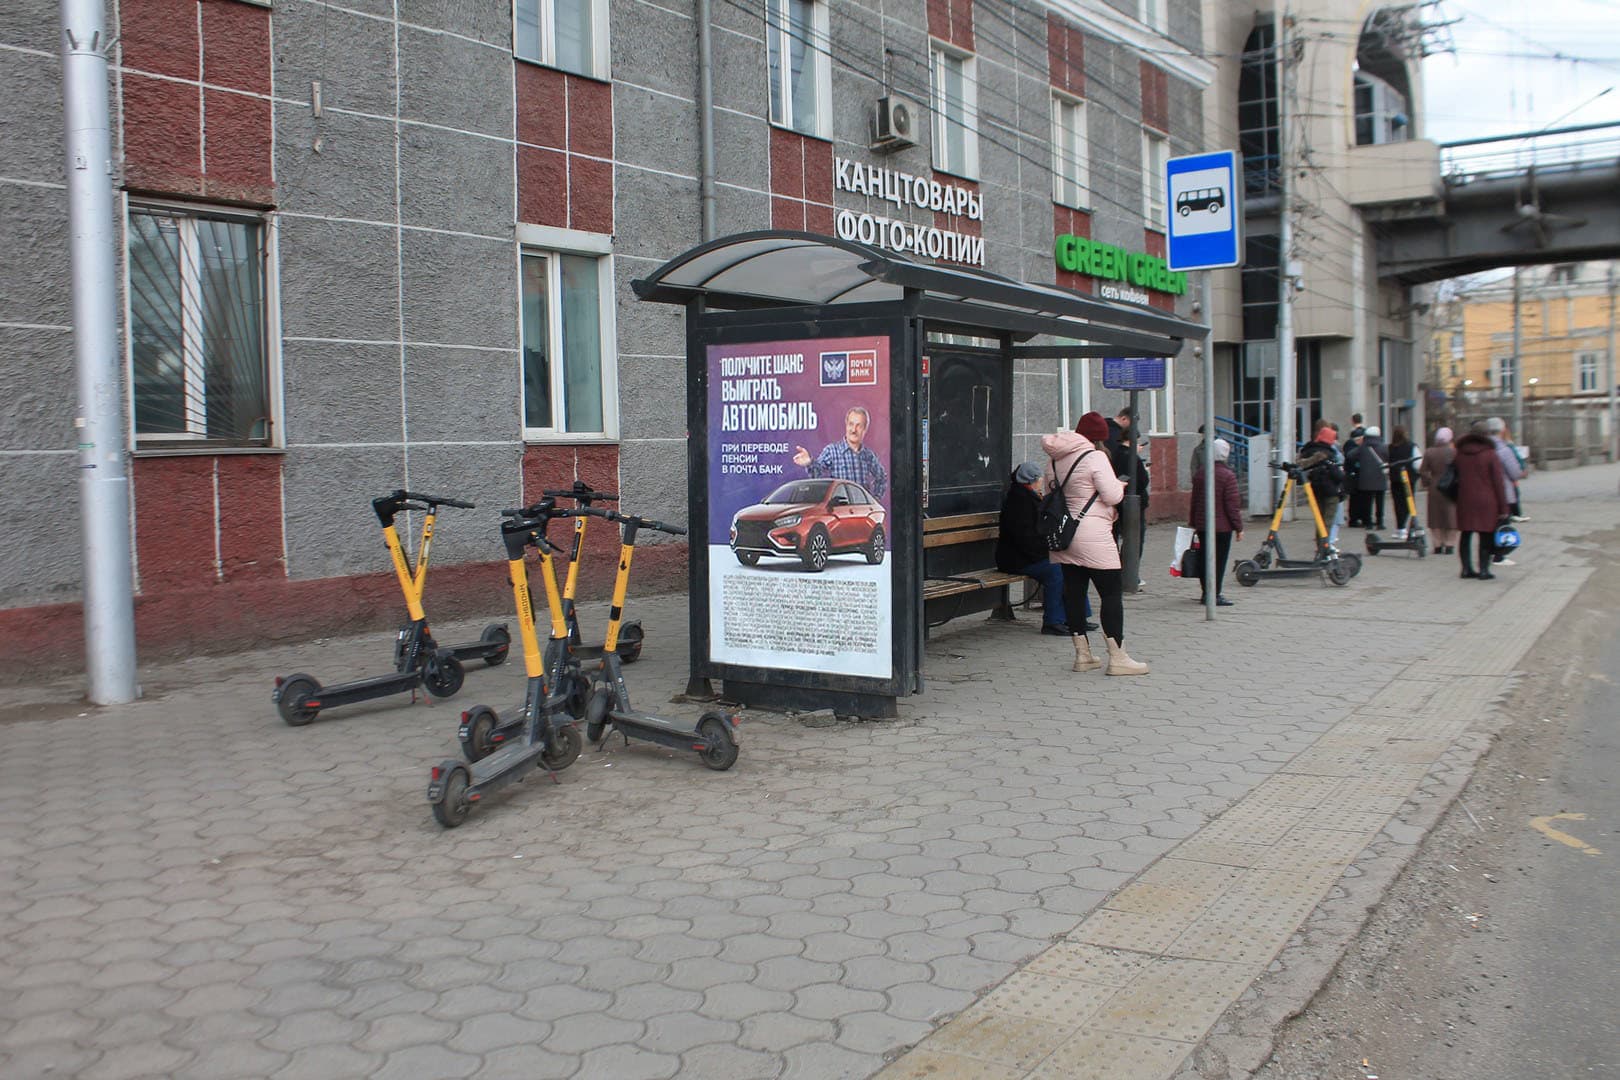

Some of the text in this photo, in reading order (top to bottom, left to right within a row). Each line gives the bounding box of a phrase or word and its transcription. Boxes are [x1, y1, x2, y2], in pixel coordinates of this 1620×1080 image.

[835, 157, 984, 221] КАНЦТОВАРЫ
[1055, 233, 1187, 296] GREEN GREEN
[1101, 285, 1120, 299] сеть
[721, 354, 804, 377] ПОЛУЧИТЕ ШАНС
[850, 359, 873, 368] ПОЧТА
[850, 368, 870, 377] БАНК
[721, 378, 782, 402] ВЫИГРАТЬ
[722, 402, 818, 431] АВТОМОБИЛЬ
[721, 442, 789, 454] ПРИ ПЕРЕВОДЕ
[721, 454, 758, 463] ПЕНСИИ
[722, 464, 784, 474] В ПОЧТА БАНК
